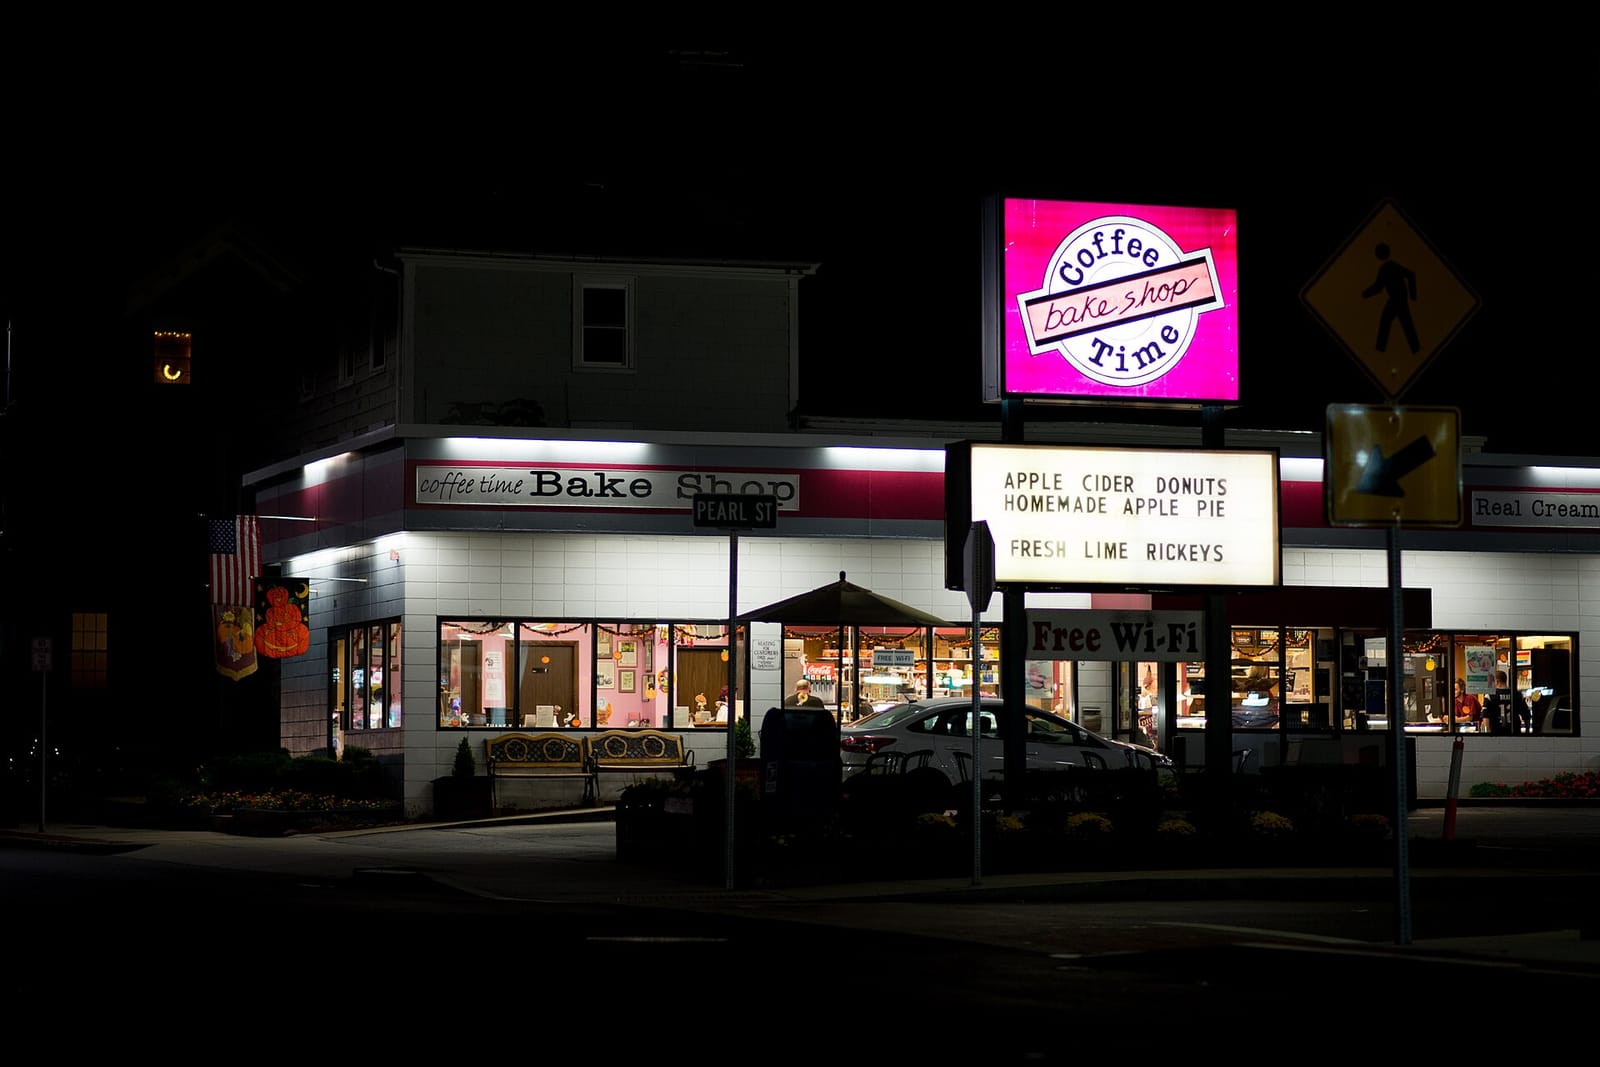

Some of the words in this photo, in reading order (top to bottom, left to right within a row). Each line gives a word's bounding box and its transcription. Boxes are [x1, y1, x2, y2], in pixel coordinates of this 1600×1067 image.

[1059, 228, 1159, 286] Coffee
[1044, 296, 1118, 332] bake
[1118, 277, 1199, 315] shop
[1088, 324, 1179, 372] Time
[420, 471, 475, 500] coffee
[479, 473, 523, 495] time
[530, 470, 652, 498] Bake
[1004, 472, 1062, 490] APPLE
[1082, 474, 1134, 493] CIDER
[1156, 476, 1227, 496] DONUTS
[696, 500, 748, 521] PEARL
[755, 502, 774, 522] ST
[1004, 494, 1107, 514] HOMEMADE
[1123, 497, 1178, 516] APPLE
[1197, 499, 1225, 517] PIE
[1475, 498, 1522, 516] Real
[1531, 500, 1600, 518] Cream
[1011, 539, 1066, 558] FRESH
[1085, 541, 1128, 559] LIME
[1146, 543, 1223, 562] RICKEYS
[1033, 621, 1101, 651] Free
[1110, 622, 1198, 653] Wi-Fi
[877, 654, 893, 662] FREE
